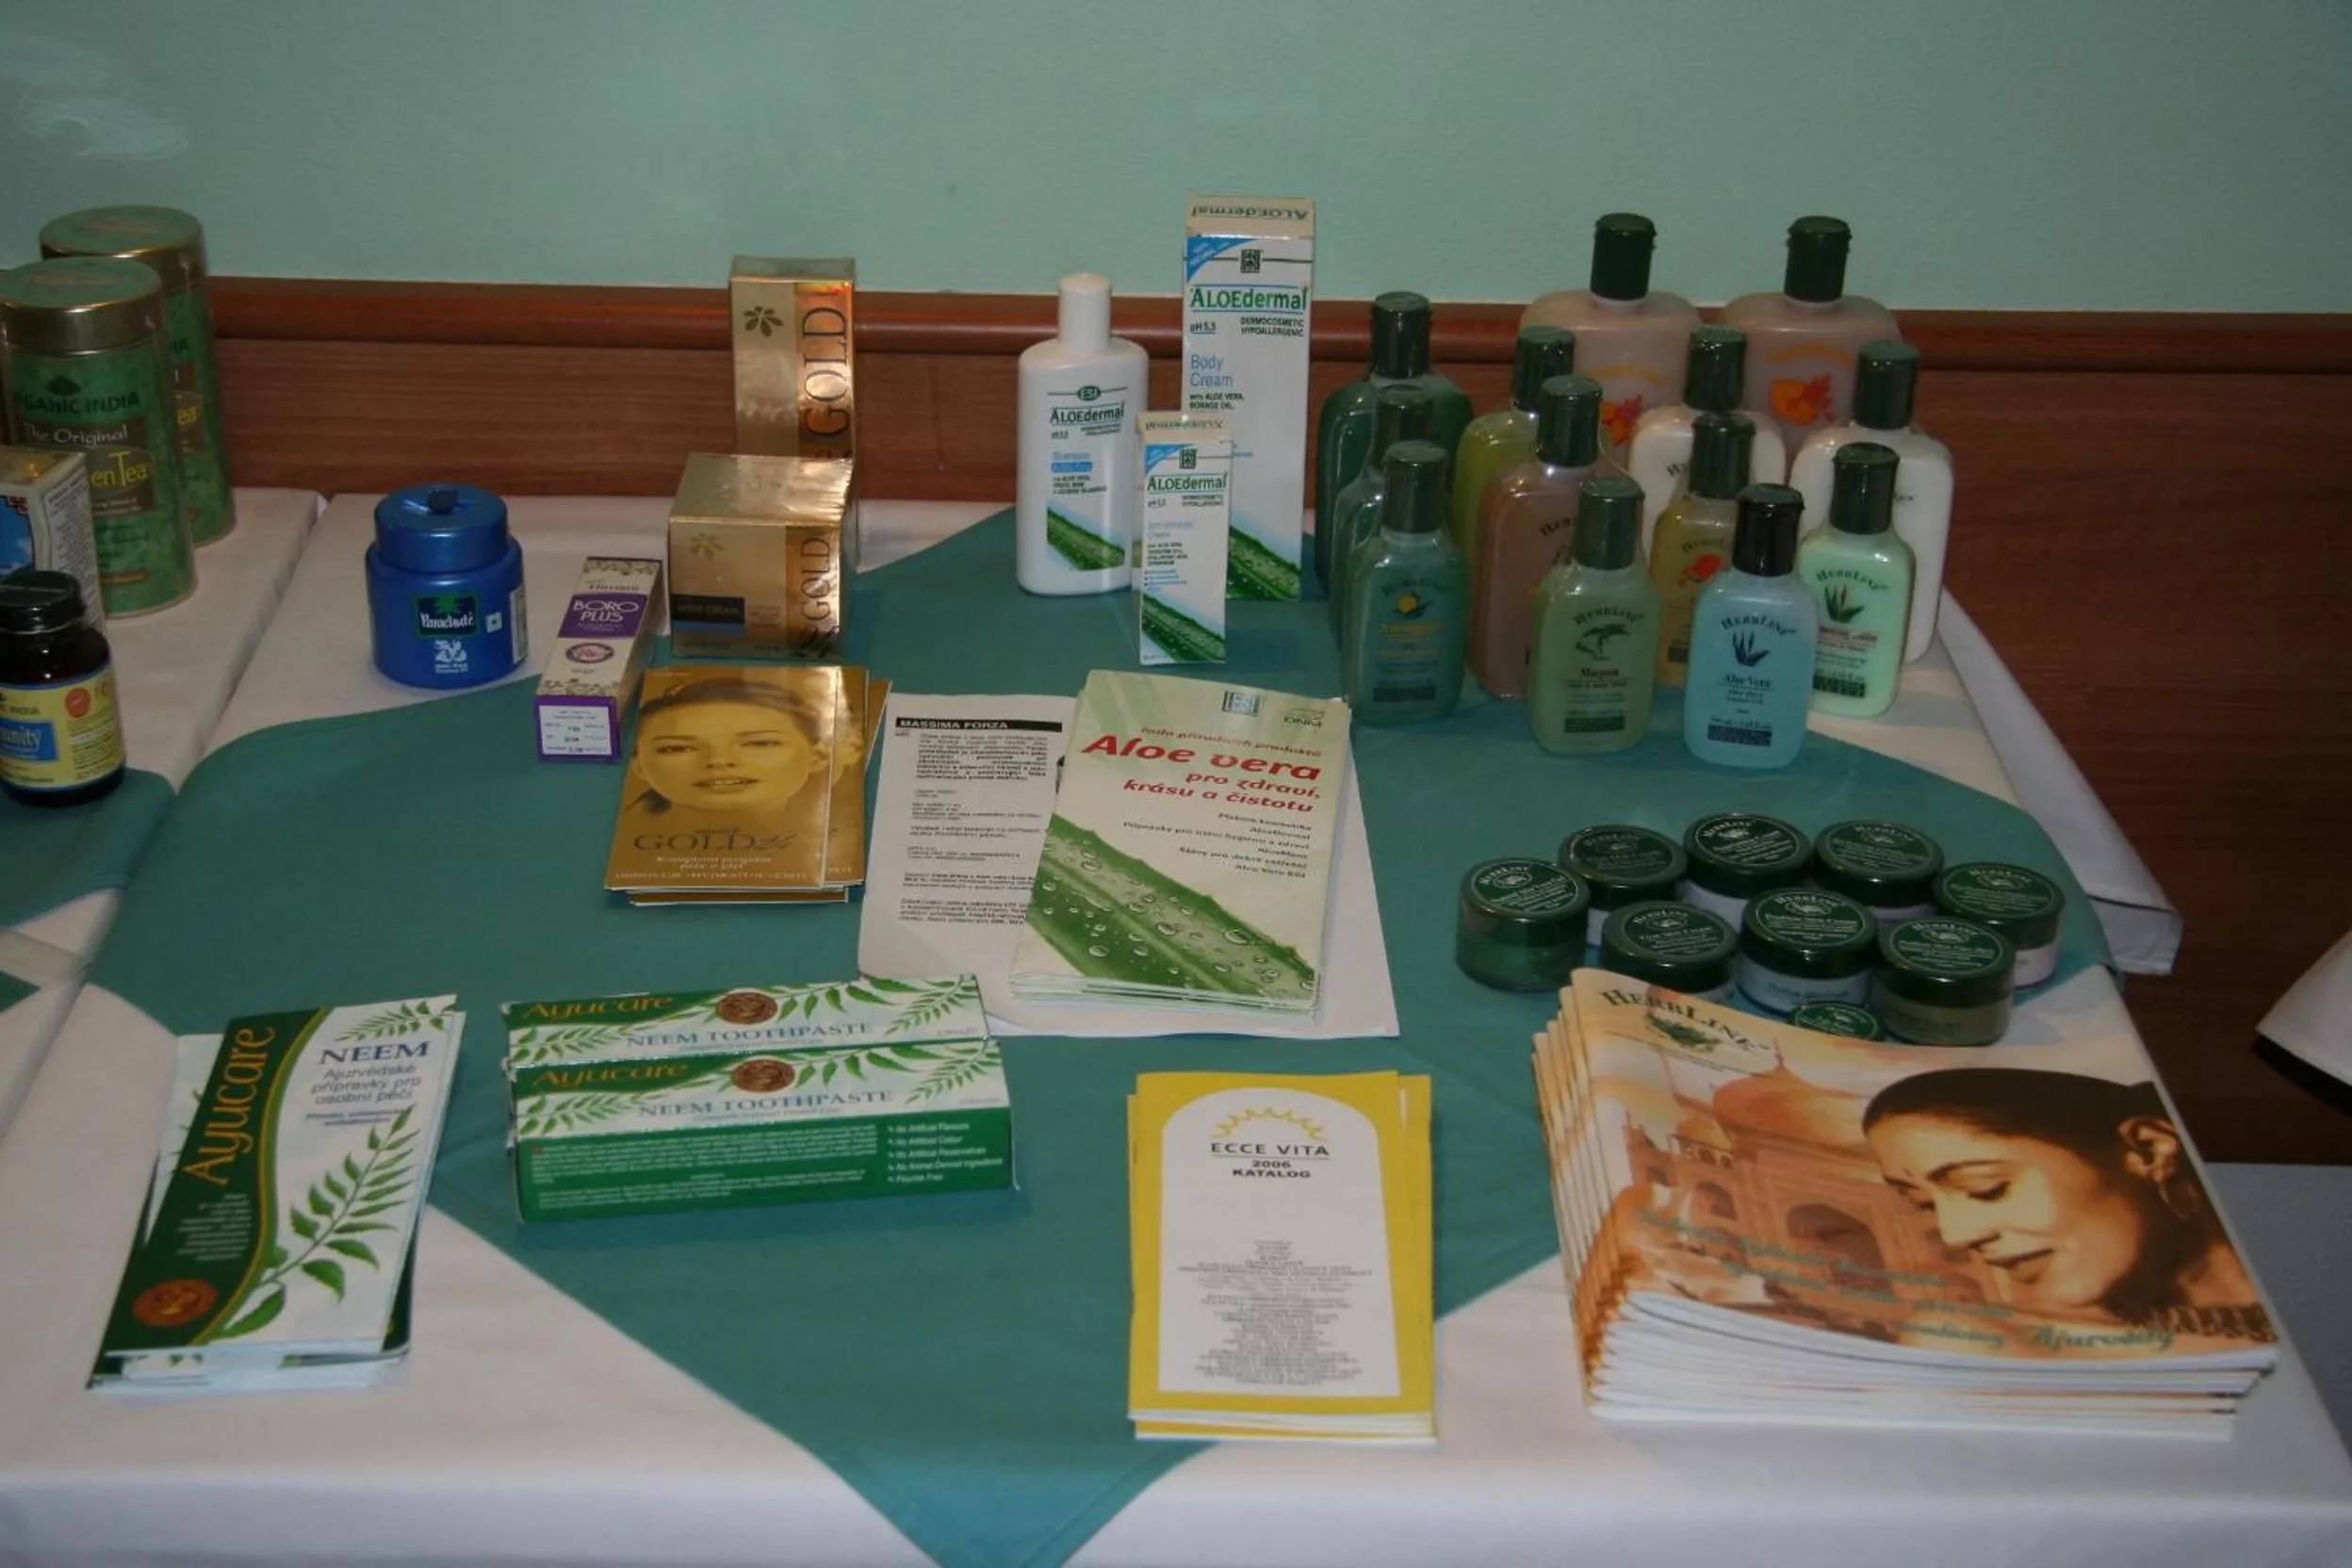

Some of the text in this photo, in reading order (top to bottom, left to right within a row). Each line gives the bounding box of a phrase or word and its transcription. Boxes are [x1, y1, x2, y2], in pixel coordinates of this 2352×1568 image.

[1190, 286, 1308, 310] ALOEdermal
[803, 307, 850, 436] GOLD
[1191, 354, 1224, 372] Body
[1190, 372, 1233, 388] Cream
[86, 391, 140, 415] INDIA
[1051, 402, 1124, 424] ALOEdermal
[24, 422, 128, 450] The Original
[108, 450, 148, 488] Tea
[1148, 473, 1228, 490] ALOEdermal
[800, 538, 830, 620] GOLD
[573, 600, 640, 612] BORO
[581, 611, 624, 623] PLUS
[900, 720, 1008, 729] MASSIMA FORZA
[1081, 735, 1321, 781] Aloe vera
[1123, 779, 1313, 812] krásu a čistotu
[1185, 772, 1320, 799] pro zdraví,
[633, 832, 757, 851] GOLD
[523, 995, 676, 1021] Ayucare
[1598, 988, 1760, 1052] HERBLINE
[628, 1032, 697, 1047] NEEM
[708, 1021, 874, 1042] TOOTHPASTE
[318, 1041, 432, 1064] NEEM
[394, 1077, 422, 1090] pro
[532, 1062, 689, 1087] Ayucare
[181, 1027, 276, 1185] Ayucare
[639, 1091, 893, 1117] NEEM TOOTHPASTE
[1211, 1142, 1331, 1155] ECCE VITA
[1233, 1168, 1312, 1179] KATALOG
[1251, 1159, 1291, 1168] 2006
